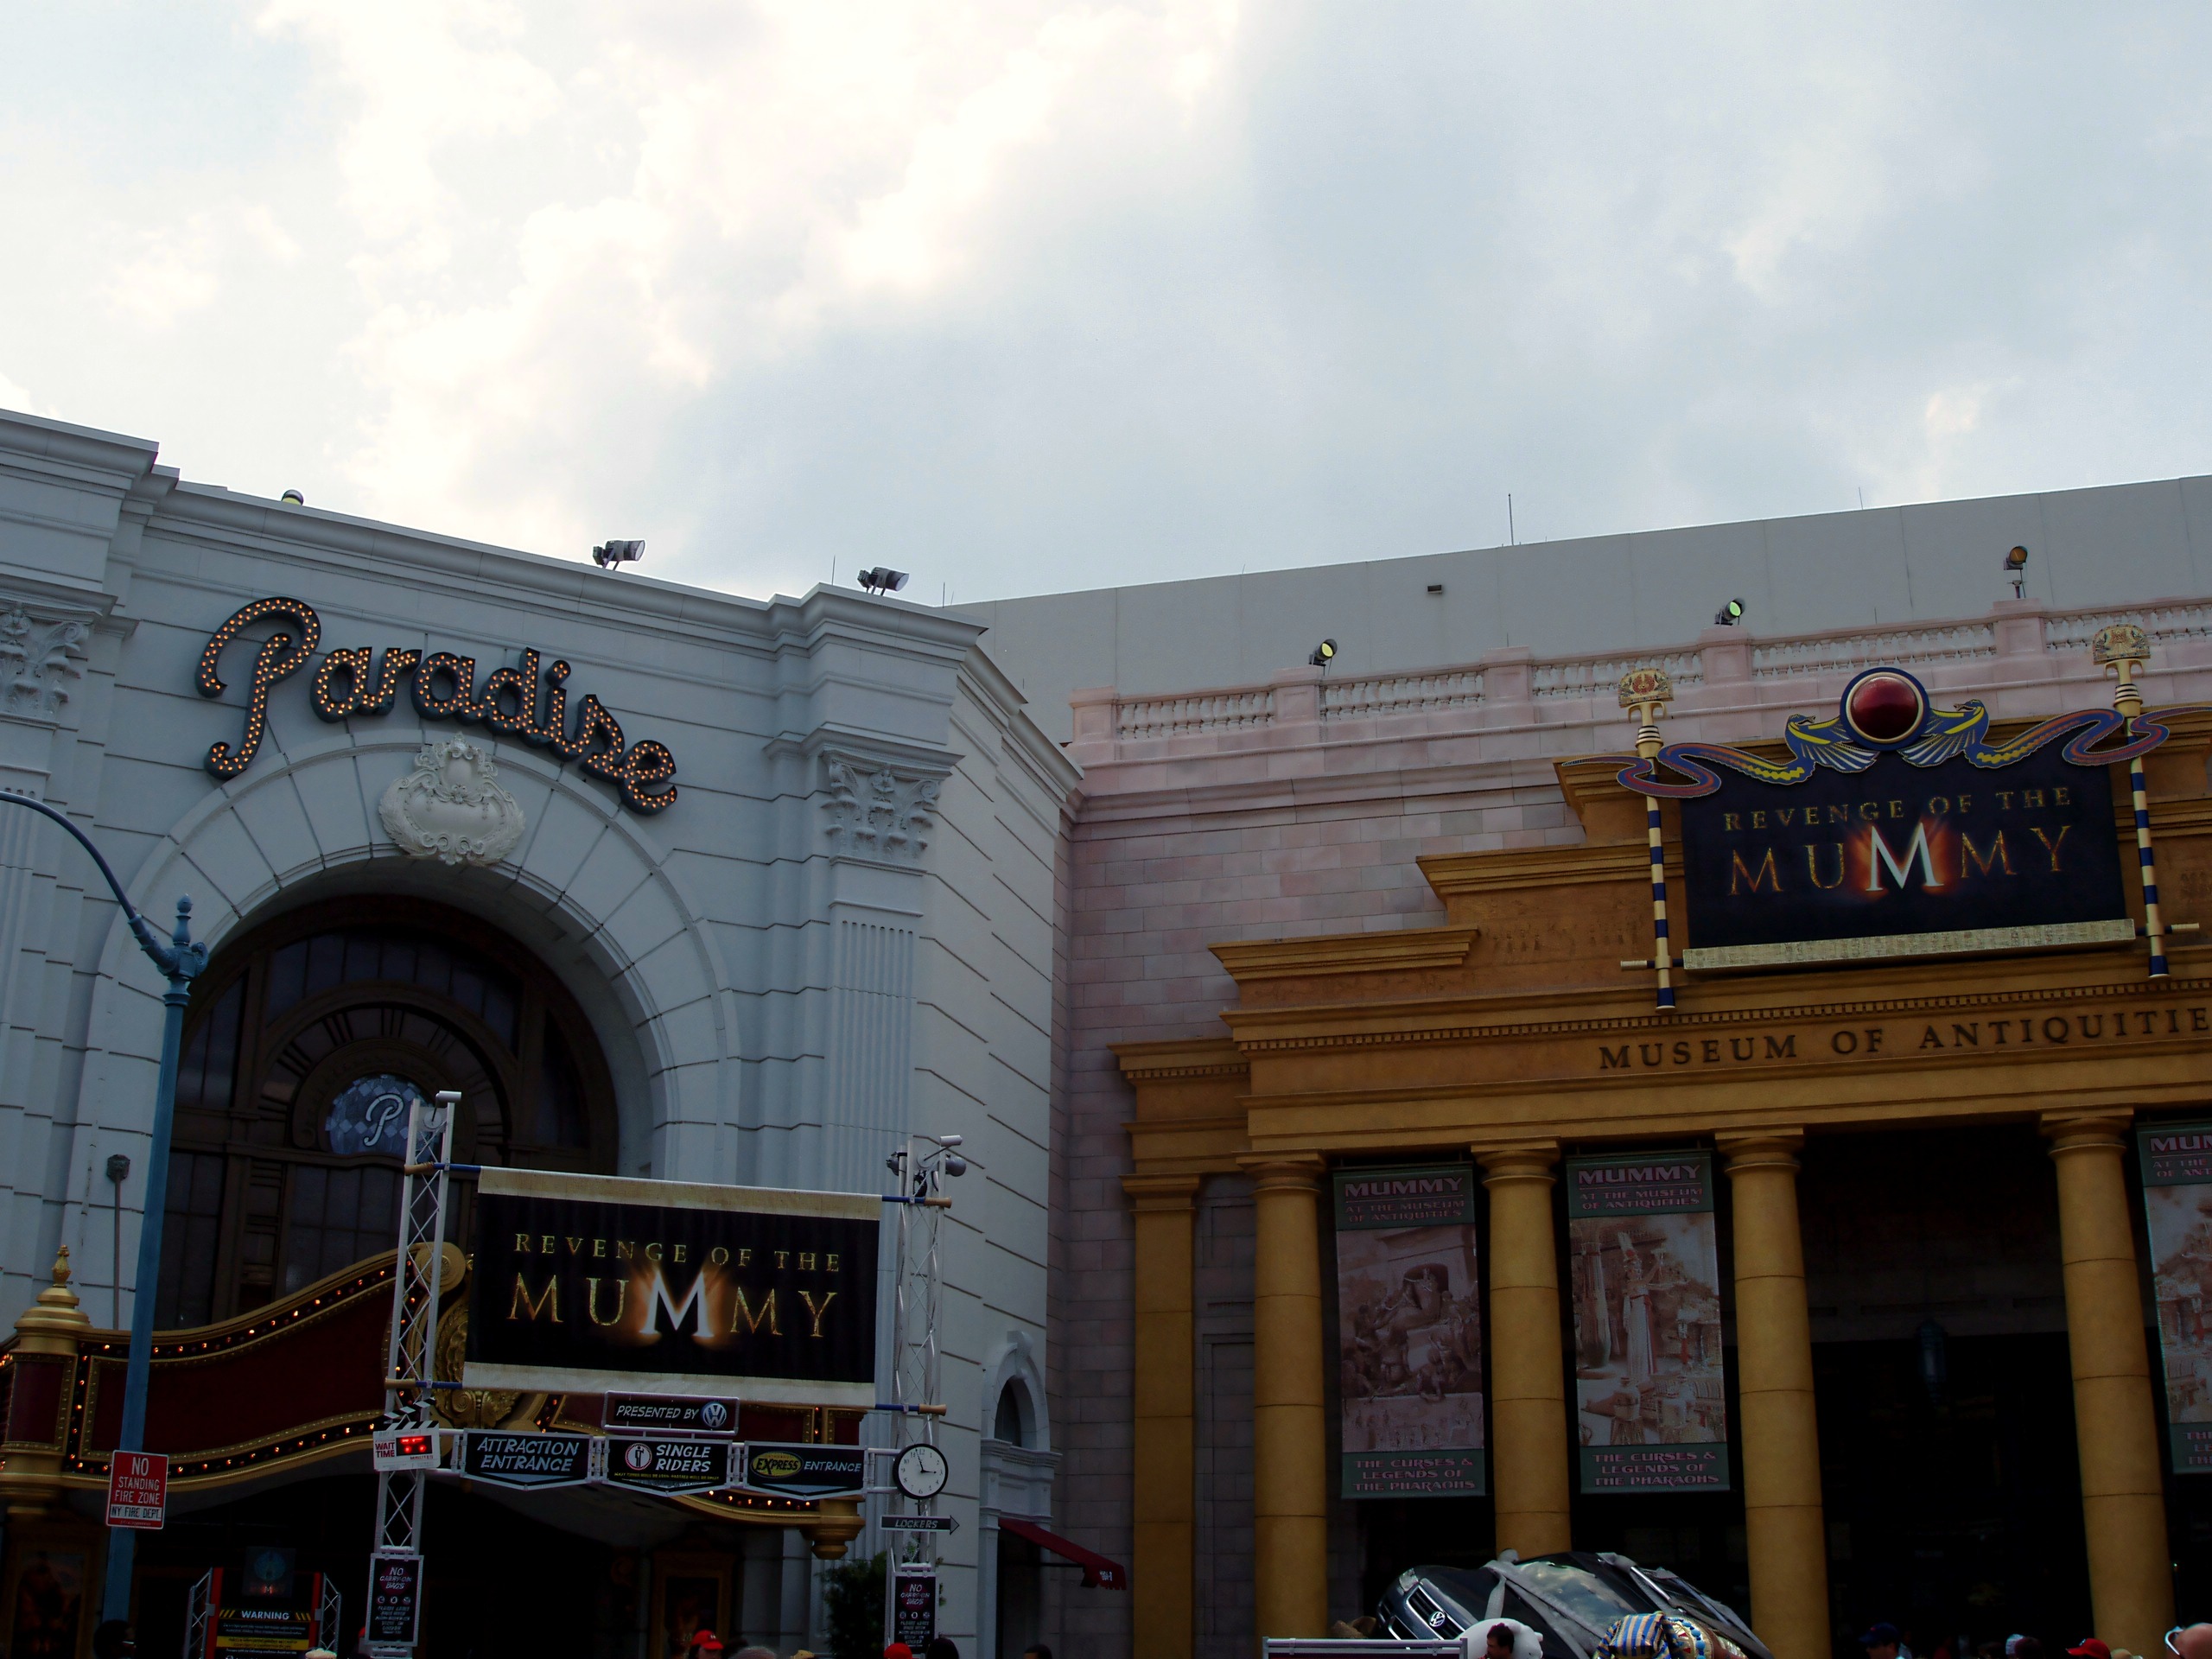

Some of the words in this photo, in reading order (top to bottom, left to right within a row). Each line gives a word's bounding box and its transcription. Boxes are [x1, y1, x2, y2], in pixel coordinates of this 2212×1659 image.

[195, 596, 677, 816] Paradise
[1723, 800, 1904, 831] REVENGE
[1928, 795, 1973, 816] OF
[1995, 786, 2073, 810] THE
[1727, 822, 2073, 896] MUMMY
[1599, 1034, 1797, 1069] MUSEUM
[1830, 1028, 1884, 1055] OF
[1578, 1165, 1700, 1185] MUMMY
[1344, 1177, 1462, 1198] MUMMY
[1636, 1188, 1702, 1198] MUSEUM
[1400, 1200, 1465, 1210] MUSEUM
[1605, 1198, 1700, 1209] ANTIQUITIES
[1372, 1210, 1462, 1222] ANTIQUITIES
[514, 1233, 688, 1263] REVENGE
[710, 1246, 753, 1267] OF
[774, 1250, 840, 1273] THE
[506, 1268, 838, 1338] MUMMY
[616, 1405, 681, 1418] PRESENTED
[683, 1408, 699, 1420] BY
[477, 1437, 580, 1457] ATTRACTION
[656, 1443, 712, 1459] SINGLE
[480, 1454, 574, 1472] ENTRANCE
[654, 1458, 712, 1472] RIDERS
[1390, 1458, 1455, 1469] CURSES
[1461, 1458, 1473, 1466] &
[1592, 1453, 1624, 1463] THE
[1630, 1452, 1697, 1464] CURSES
[1703, 1451, 1717, 1459] &
[131, 1456, 149, 1476] NO
[756, 1458, 799, 1475] EXPRESS
[804, 1460, 862, 1472] ENTRANCE
[1601, 1464, 1680, 1474] LEGENDS
[1686, 1463, 1708, 1471] OF
[1363, 1470, 1439, 1479] LEGENDS
[1444, 1469, 1465, 1478] OF
[1594, 1477, 1624, 1486] THE
[1630, 1475, 1719, 1486] PHARAOHS
[118, 1476, 161, 1491] STANDING
[1389, 1480, 1476, 1492] PHARAOHS
[114, 1490, 135, 1503] FIRE
[137, 1491, 161, 1505] ZONE
[111, 1506, 122, 1515] NY
[124, 1506, 140, 1518] FIRE
[894, 1519, 938, 1529] LOCKERS
[389, 1567, 404, 1575] NO
[241, 1610, 290, 1620] WARNING
